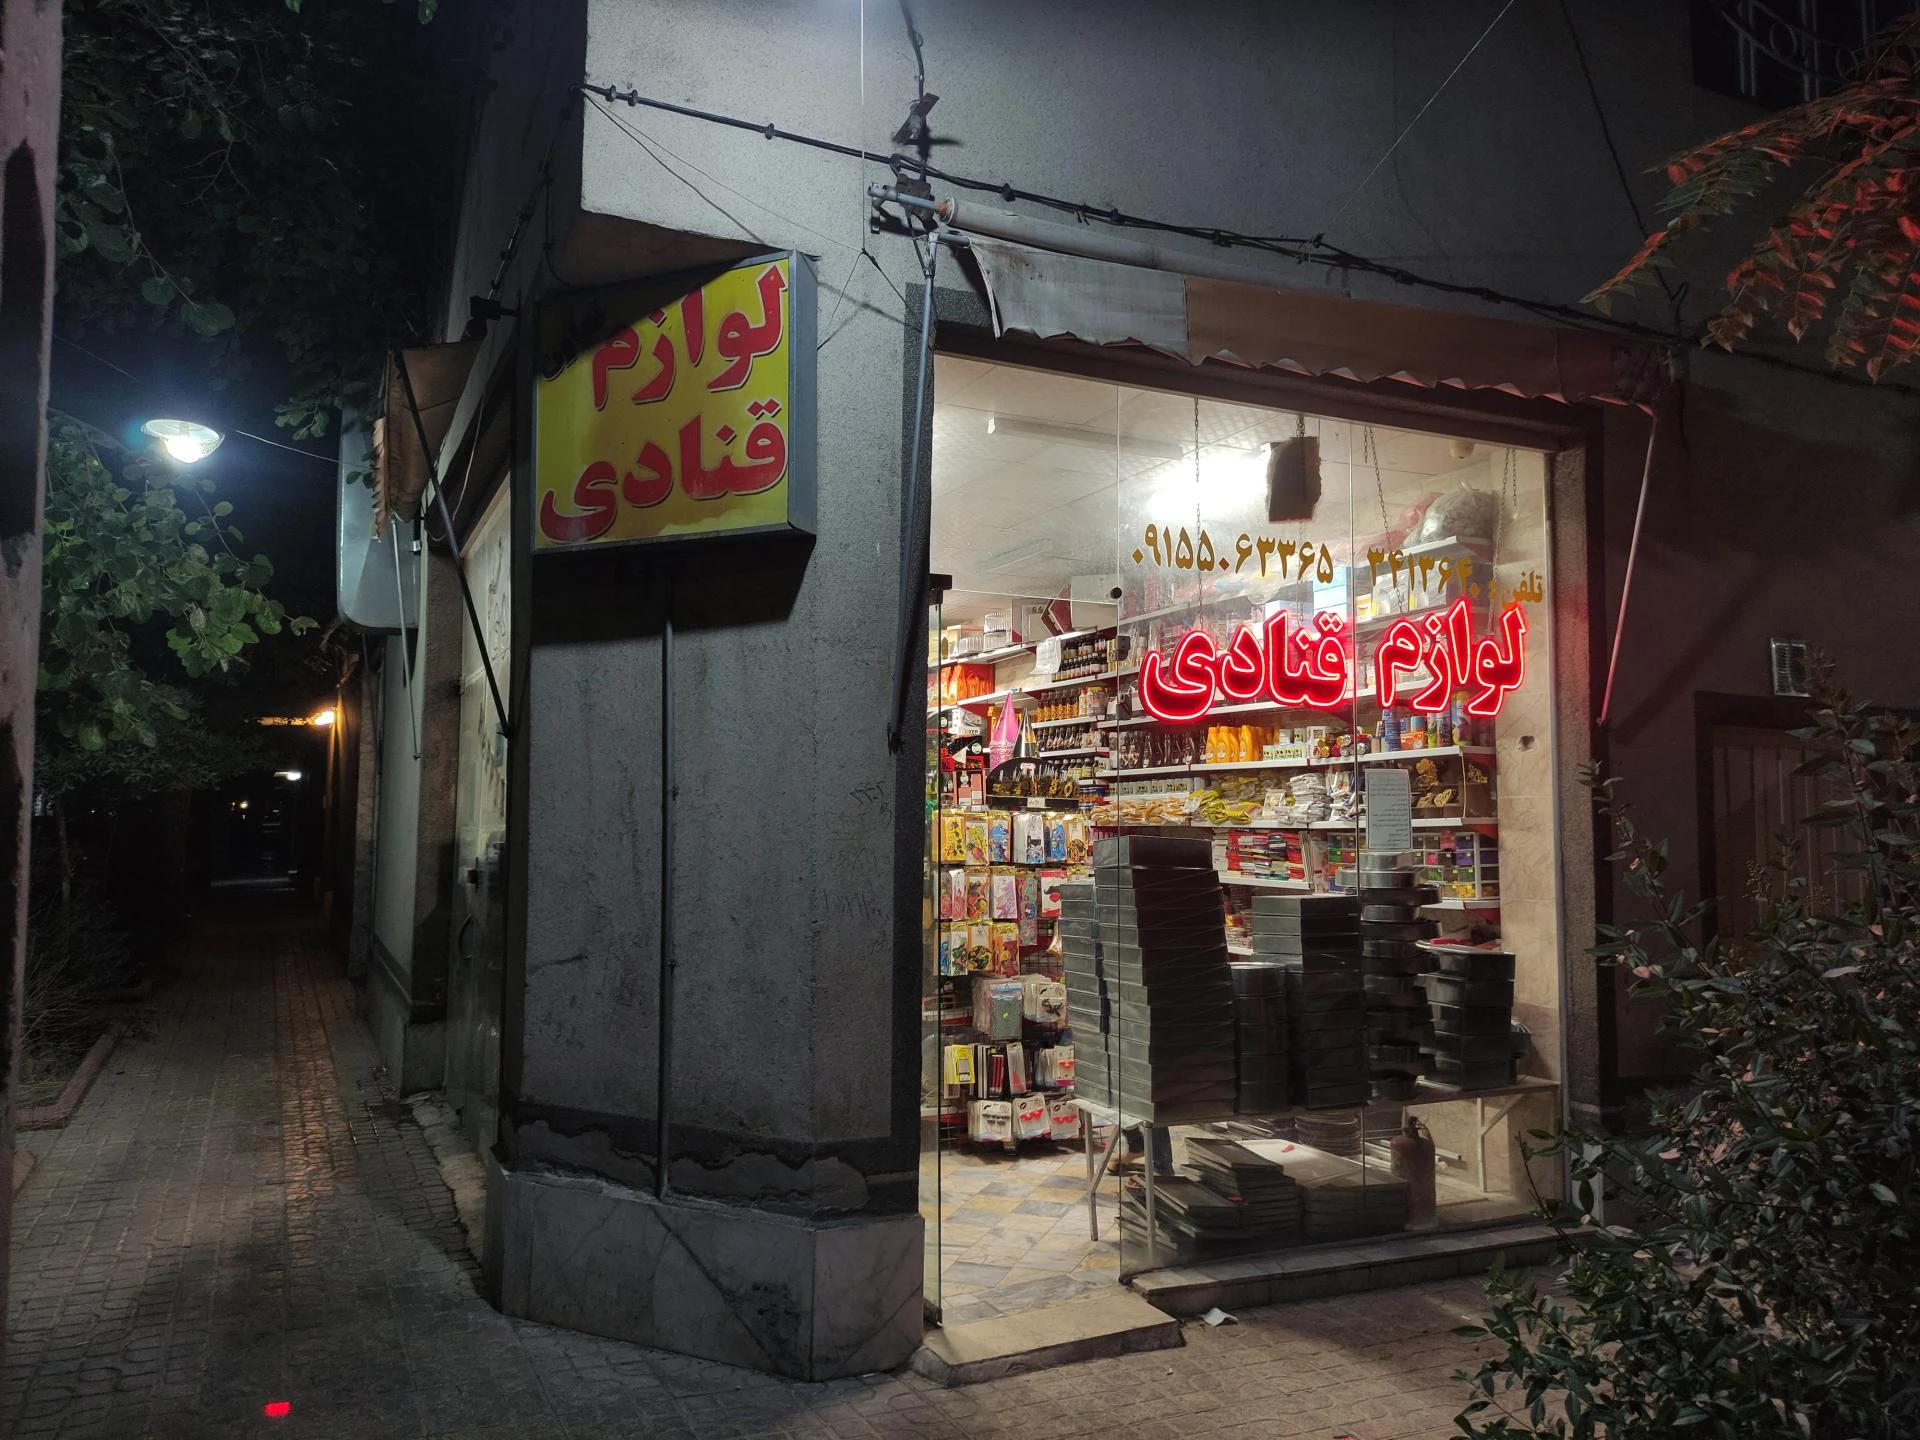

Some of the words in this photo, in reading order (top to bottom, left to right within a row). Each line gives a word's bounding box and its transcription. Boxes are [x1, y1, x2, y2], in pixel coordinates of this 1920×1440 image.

[593, 264, 787, 411] لوازم
[539, 398, 787, 543] قنادی
[1131, 522, 1334, 585] ۰۹۱۵۵۰۶۳۳۶۵
[1139, 610, 1349, 722] قنادی
[1375, 598, 1527, 717] لوازم
